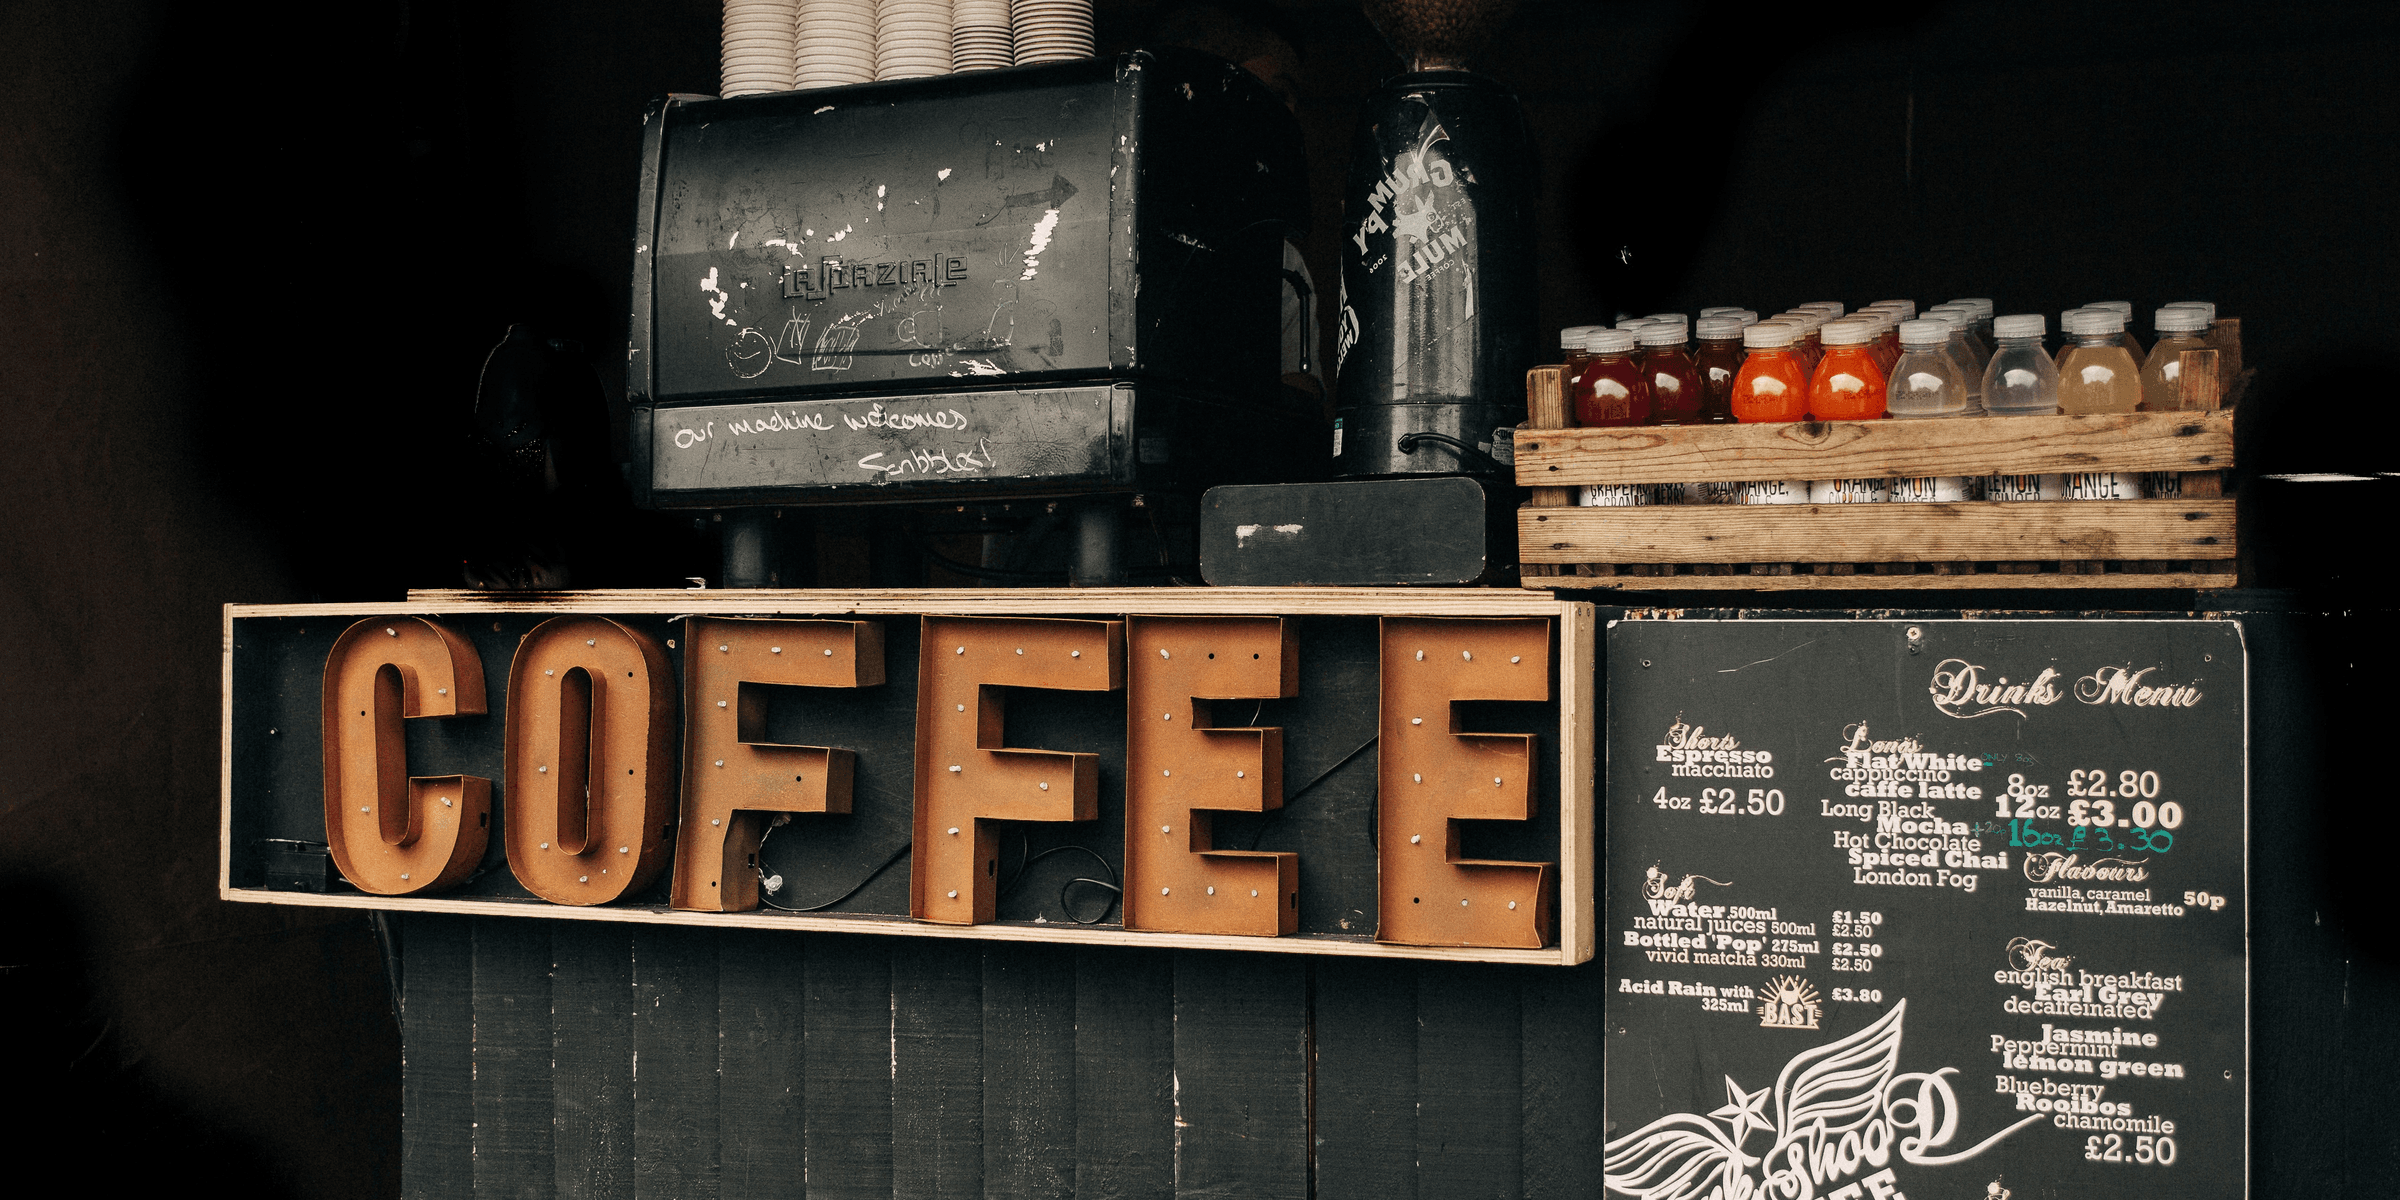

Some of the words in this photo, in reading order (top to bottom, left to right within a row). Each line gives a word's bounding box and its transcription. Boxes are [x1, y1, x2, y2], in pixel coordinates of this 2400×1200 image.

[729, 409, 834, 436] machine
[1929, 658, 2063, 719] Drinks
[2074, 665, 2203, 707] Menu
[1664, 722, 1740, 750] Shorts
[1656, 745, 1773, 767] Espresso
[1845, 752, 1899, 770] Flat
[1902, 752, 1983, 771] White
[1672, 762, 1774, 778] macchiato
[1830, 767, 1951, 785] cappuccino
[321, 616, 1555, 949] COFFEE
[1844, 780, 1913, 798] caffe
[1918, 782, 1982, 800] latte
[2007, 773, 2050, 798] 8oz
[2066, 769, 2160, 798] £2.80
[1653, 786, 1691, 809] 4oz
[1699, 788, 1785, 815] £2.50
[1820, 799, 1873, 822] Long
[1877, 800, 1936, 819] Black
[1995, 793, 2061, 819] 12oz
[2067, 799, 2183, 829] £3.00
[1876, 816, 1971, 836] Mocha
[2008, 818, 2065, 848] 16oz
[1833, 831, 1869, 848] Hot
[1874, 832, 1982, 852] Chocolate
[1848, 848, 1939, 870] Spiced
[1944, 850, 2009, 869] Chai
[2023, 851, 2150, 883] Flavours
[1642, 866, 1732, 904] Soft
[1853, 866, 1933, 886] London
[1936, 868, 1978, 893] Fog
[2028, 886, 2085, 901] vanilla,
[2086, 888, 2151, 902] caramel
[2183, 890, 2226, 910] 50p
[1649, 899, 1726, 919] Water
[1729, 907, 1777, 920] 500ml
[1832, 910, 1883, 925] £1.50
[2104, 900, 2185, 916] Amaretto
[1633, 914, 1703, 931] natural
[1706, 915, 1767, 935] juices
[1770, 921, 1816, 936] 500ml
[1832, 924, 1873, 938] £2.50
[1623, 930, 1707, 949] Bottled
[1711, 934, 1768, 954] 'Pop'
[1771, 938, 1820, 953] 275ml
[1832, 942, 1883, 957] £2.50
[2005, 936, 2069, 971] Tea
[1645, 948, 1690, 964] vivid
[1693, 951, 1758, 967] matcha
[1761, 953, 1806, 968] 330ml
[1832, 958, 1873, 972] £2.50
[1618, 978, 1664, 996] Acid
[1668, 980, 1717, 998] Rain
[1720, 984, 1755, 998] with
[1832, 987, 1883, 1002] £3.80
[1994, 968, 2074, 989] english
[2078, 969, 2183, 992] breakfast
[1701, 998, 1749, 1012] 325ml
[2003, 995, 2153, 1019] decaffeinated
[2034, 983, 2093, 1003] Earl
[2098, 985, 2164, 1011] Grey
[1764, 1002, 1818, 1025] BAST
[1990, 1034, 2119, 1058] Peppermint
[2041, 1023, 2158, 1047] Jasmine
[2002, 1050, 2094, 1073] lemon
[2099, 1060, 2184, 1079] green
[1995, 1075, 2105, 1102] Blueberry
[2015, 1092, 2132, 1116] Rooibos
[2053, 1111, 2175, 1134] chamomile
[2084, 1133, 2176, 1165] £2.50
